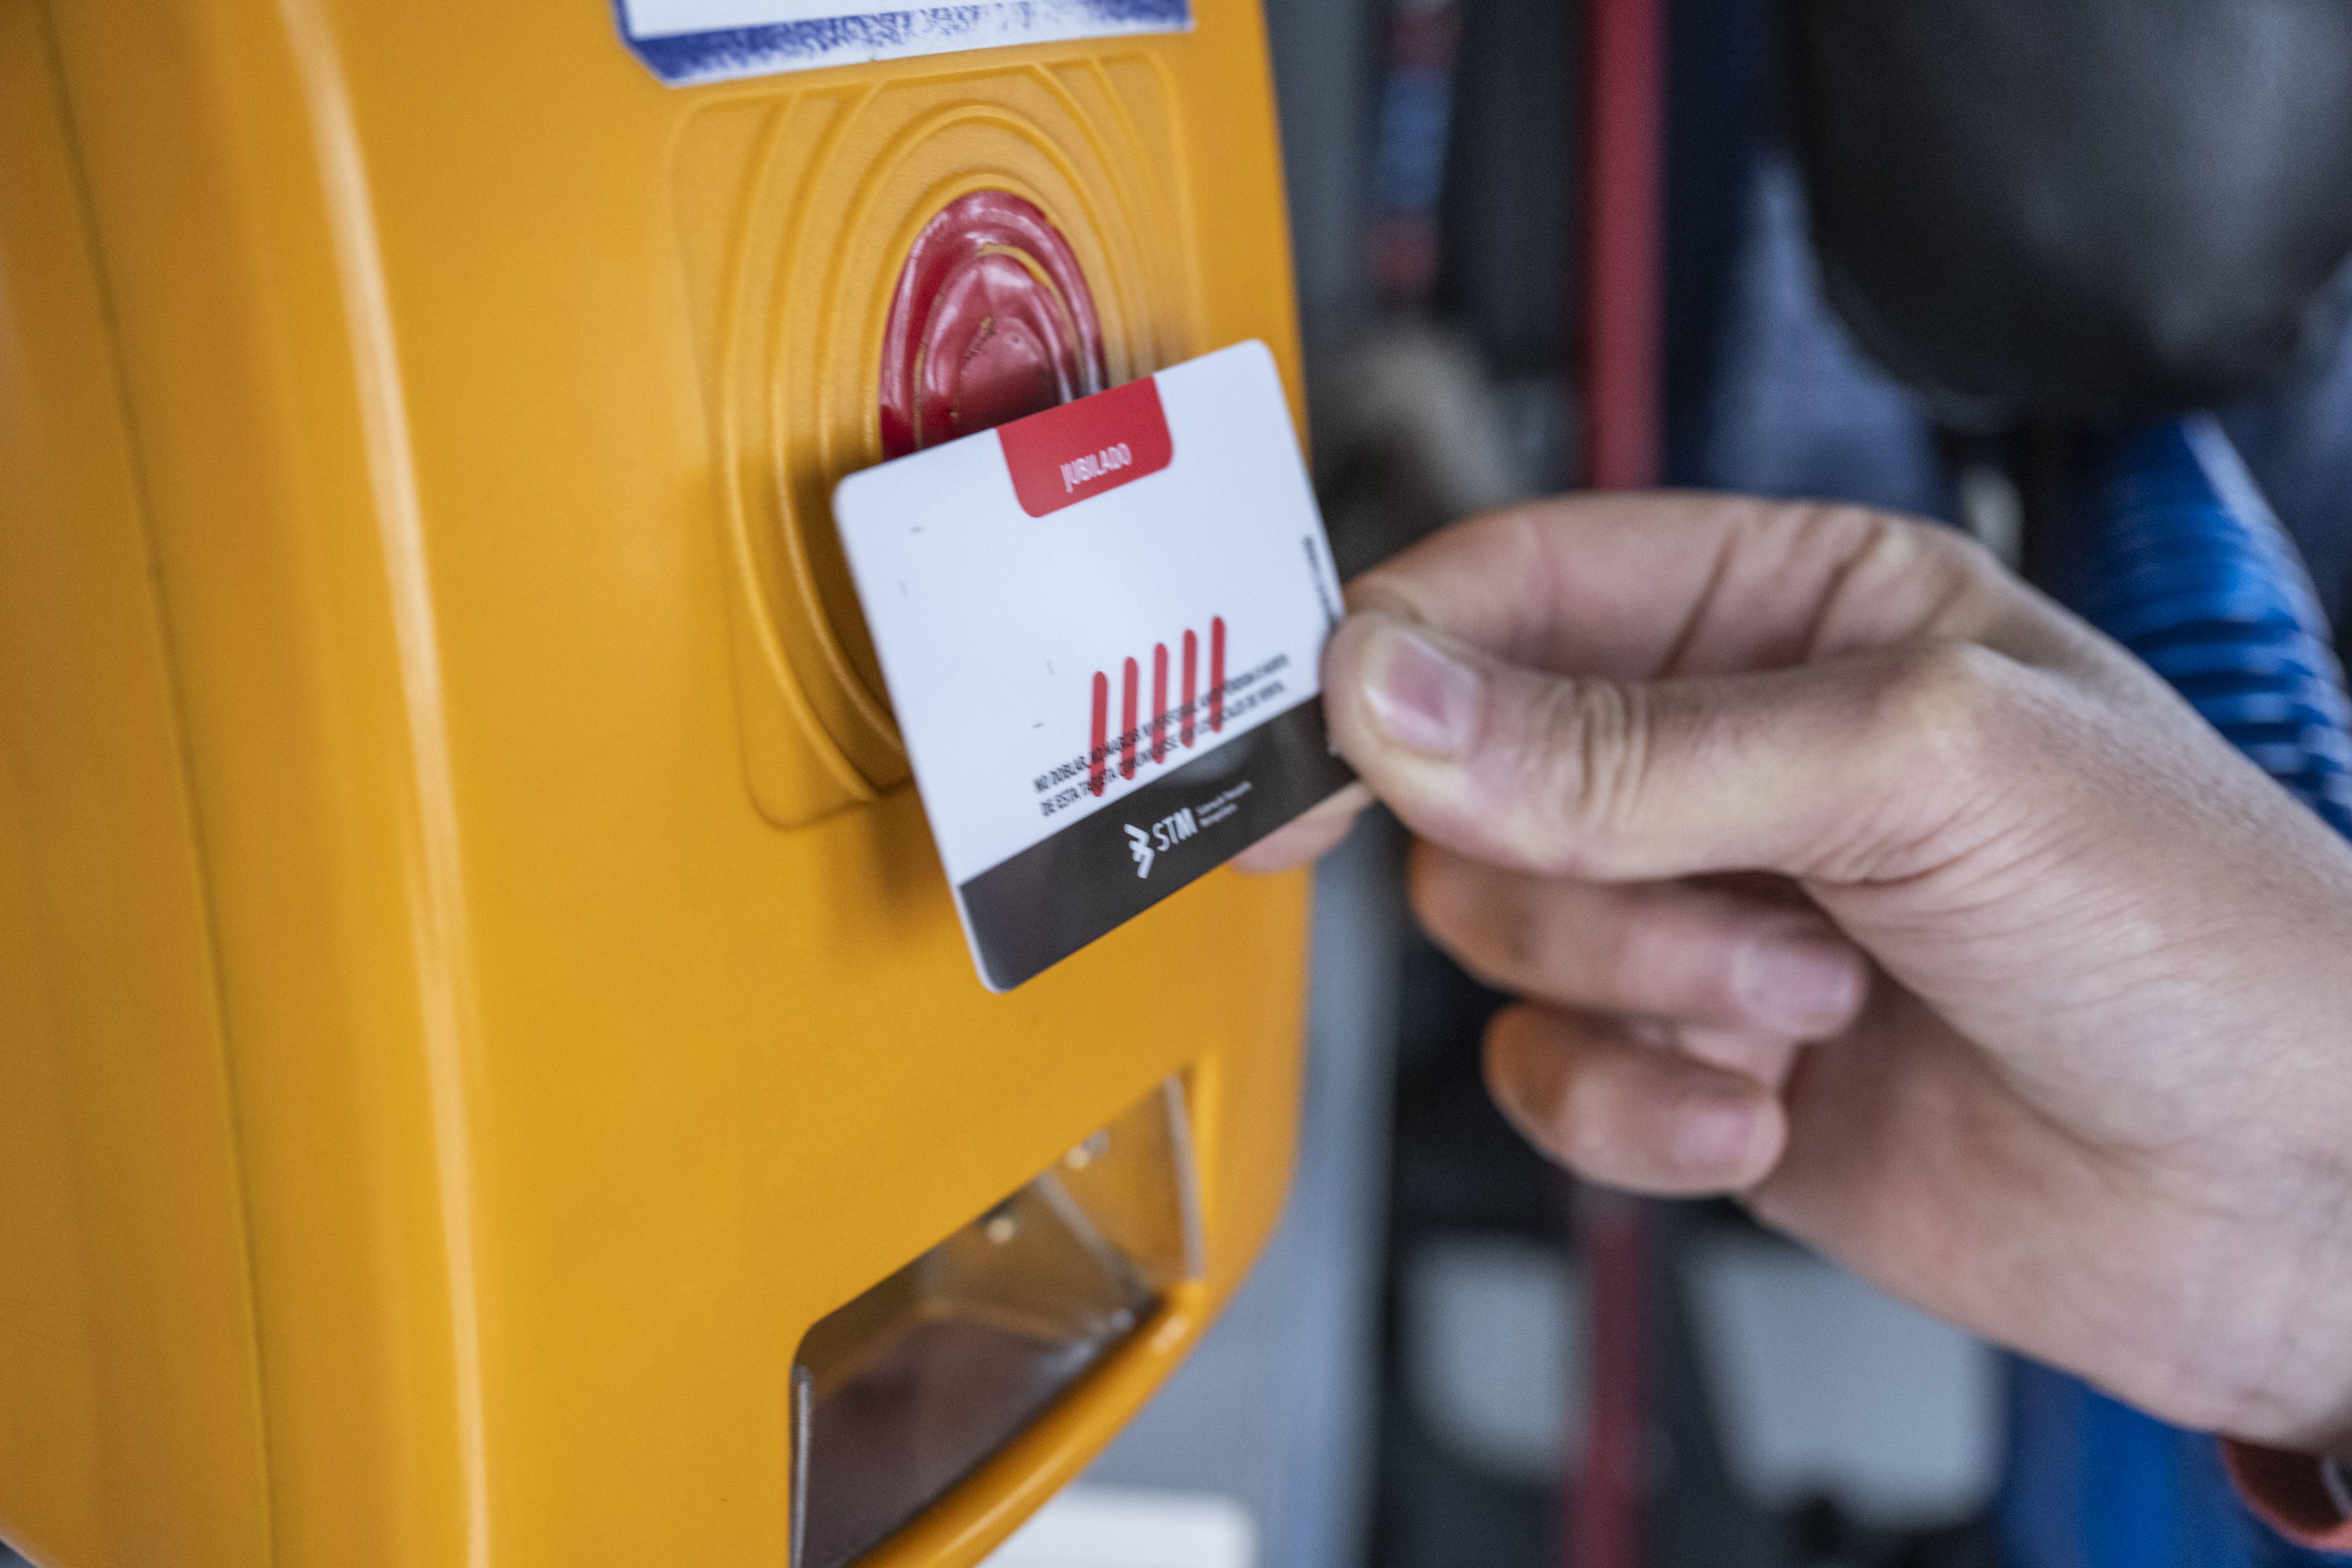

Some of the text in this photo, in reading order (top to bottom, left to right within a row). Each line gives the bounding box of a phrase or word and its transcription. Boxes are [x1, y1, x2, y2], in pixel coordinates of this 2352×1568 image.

[1060, 442, 1132, 493] JUBILADO
[1033, 775, 1050, 793] NO
[1090, 746, 1105, 765] NO
[1040, 797, 1056, 817] DE
[1054, 786, 1081, 809] ESTA
[1078, 766, 1117, 797] TARJETA
[1152, 807, 1198, 851] STM
